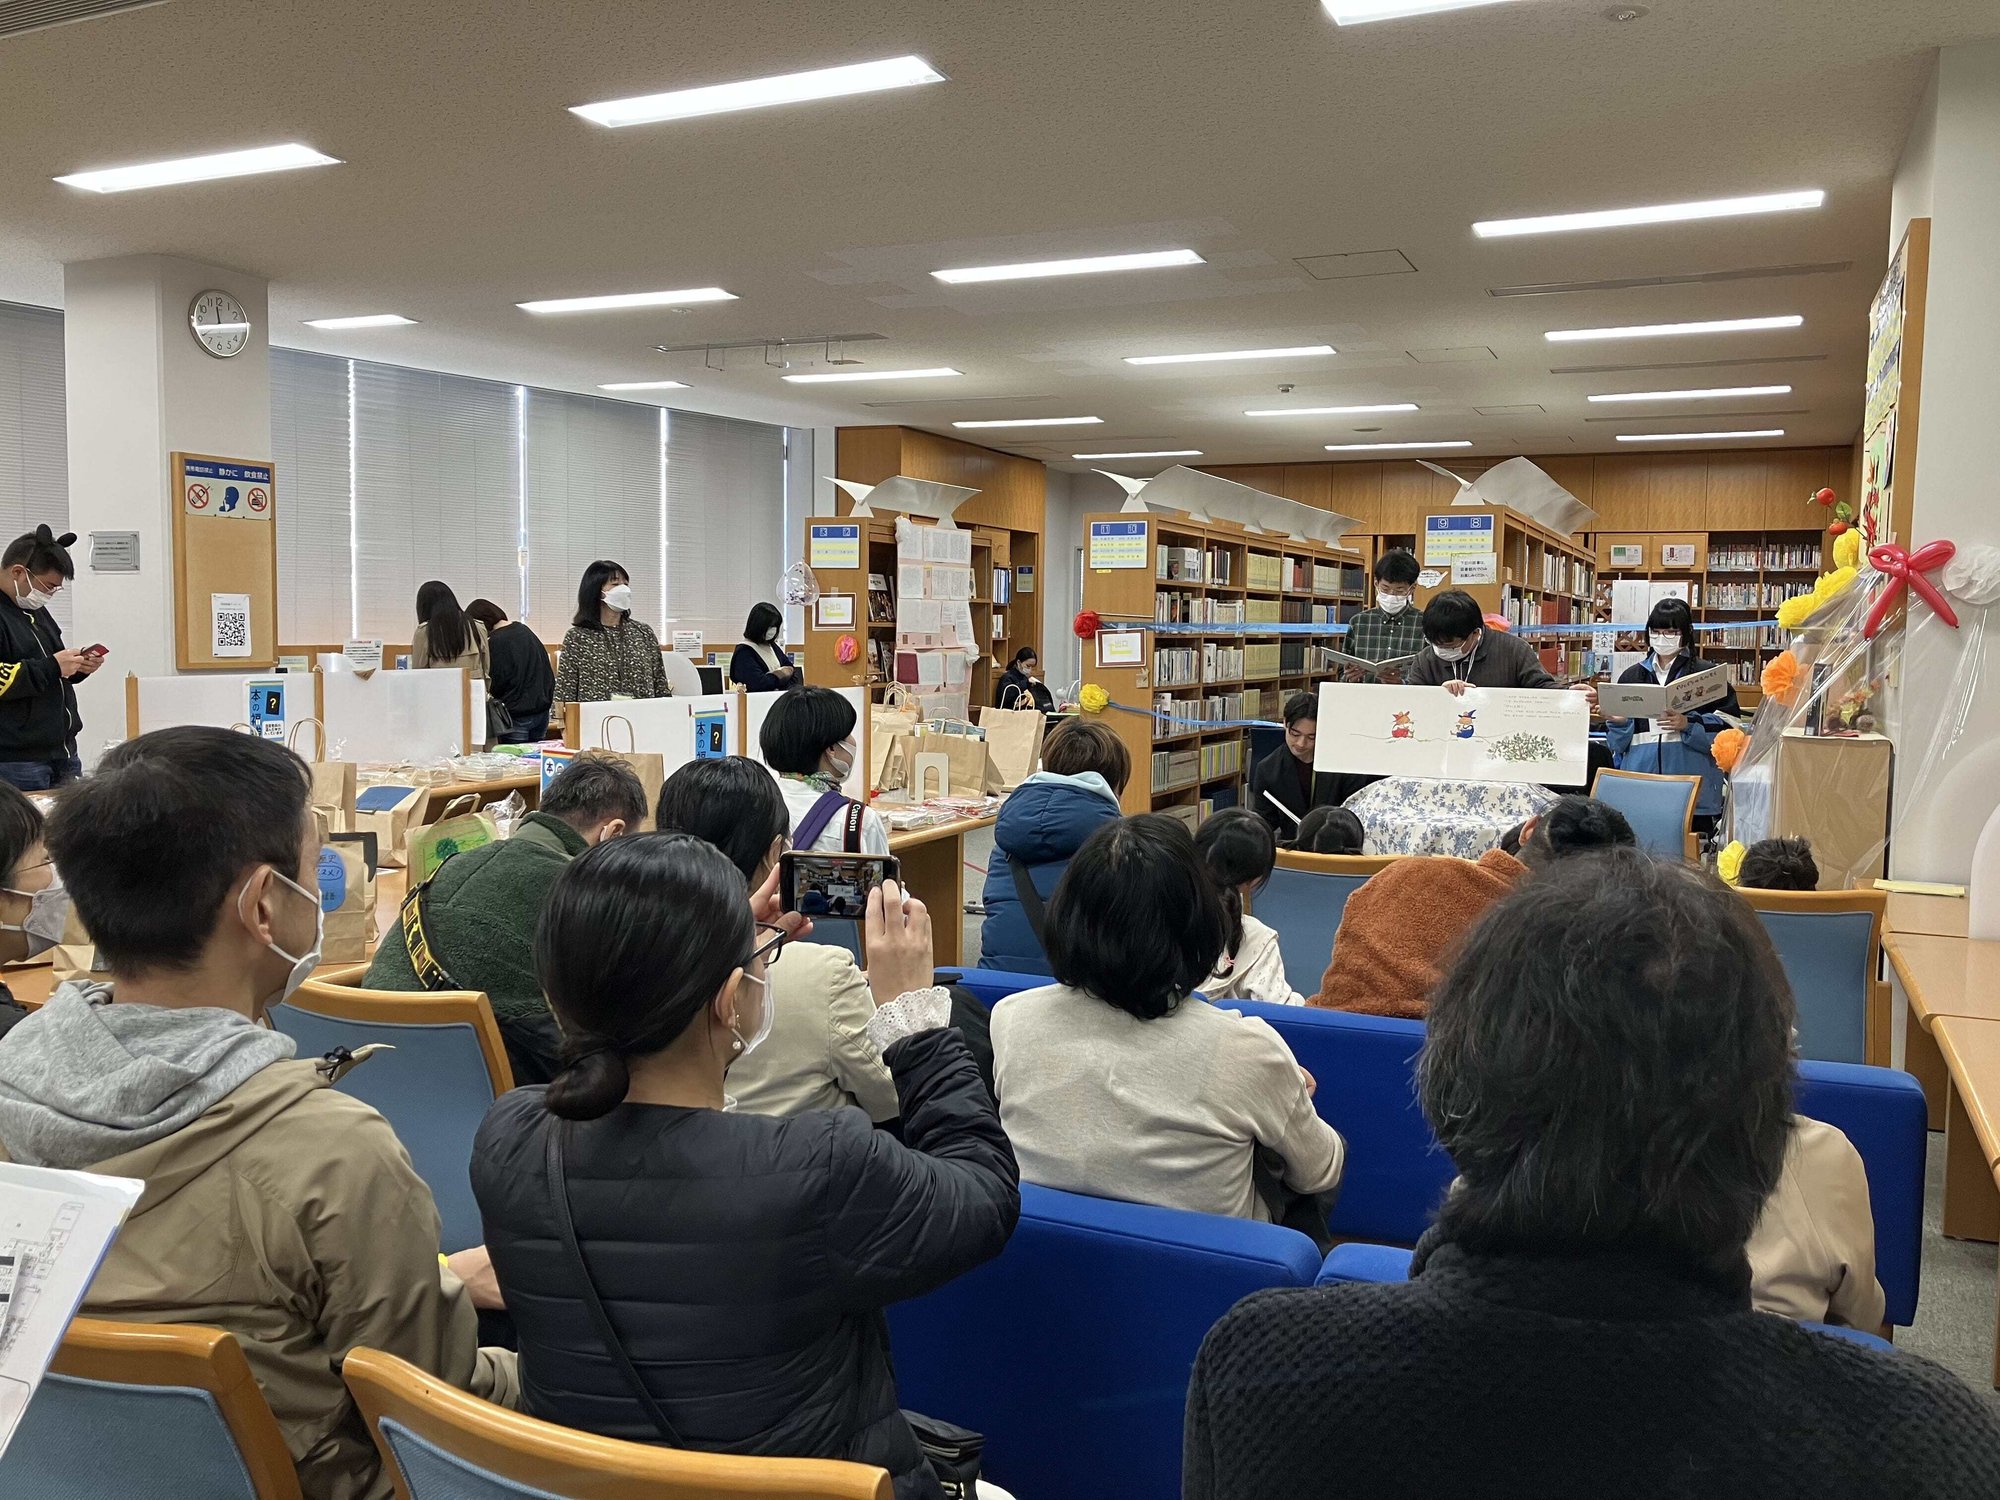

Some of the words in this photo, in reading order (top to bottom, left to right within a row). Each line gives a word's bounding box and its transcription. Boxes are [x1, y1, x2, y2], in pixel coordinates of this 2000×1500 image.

[216, 296, 222, 306] 12
[232, 311, 238, 320] 2
[217, 342, 222, 350] 6
[227, 341, 231, 349] 5
[218, 468, 238, 477] 静かに
[244, 470, 268, 480] 飲食禁止
[849, 804, 860, 832] Canon
